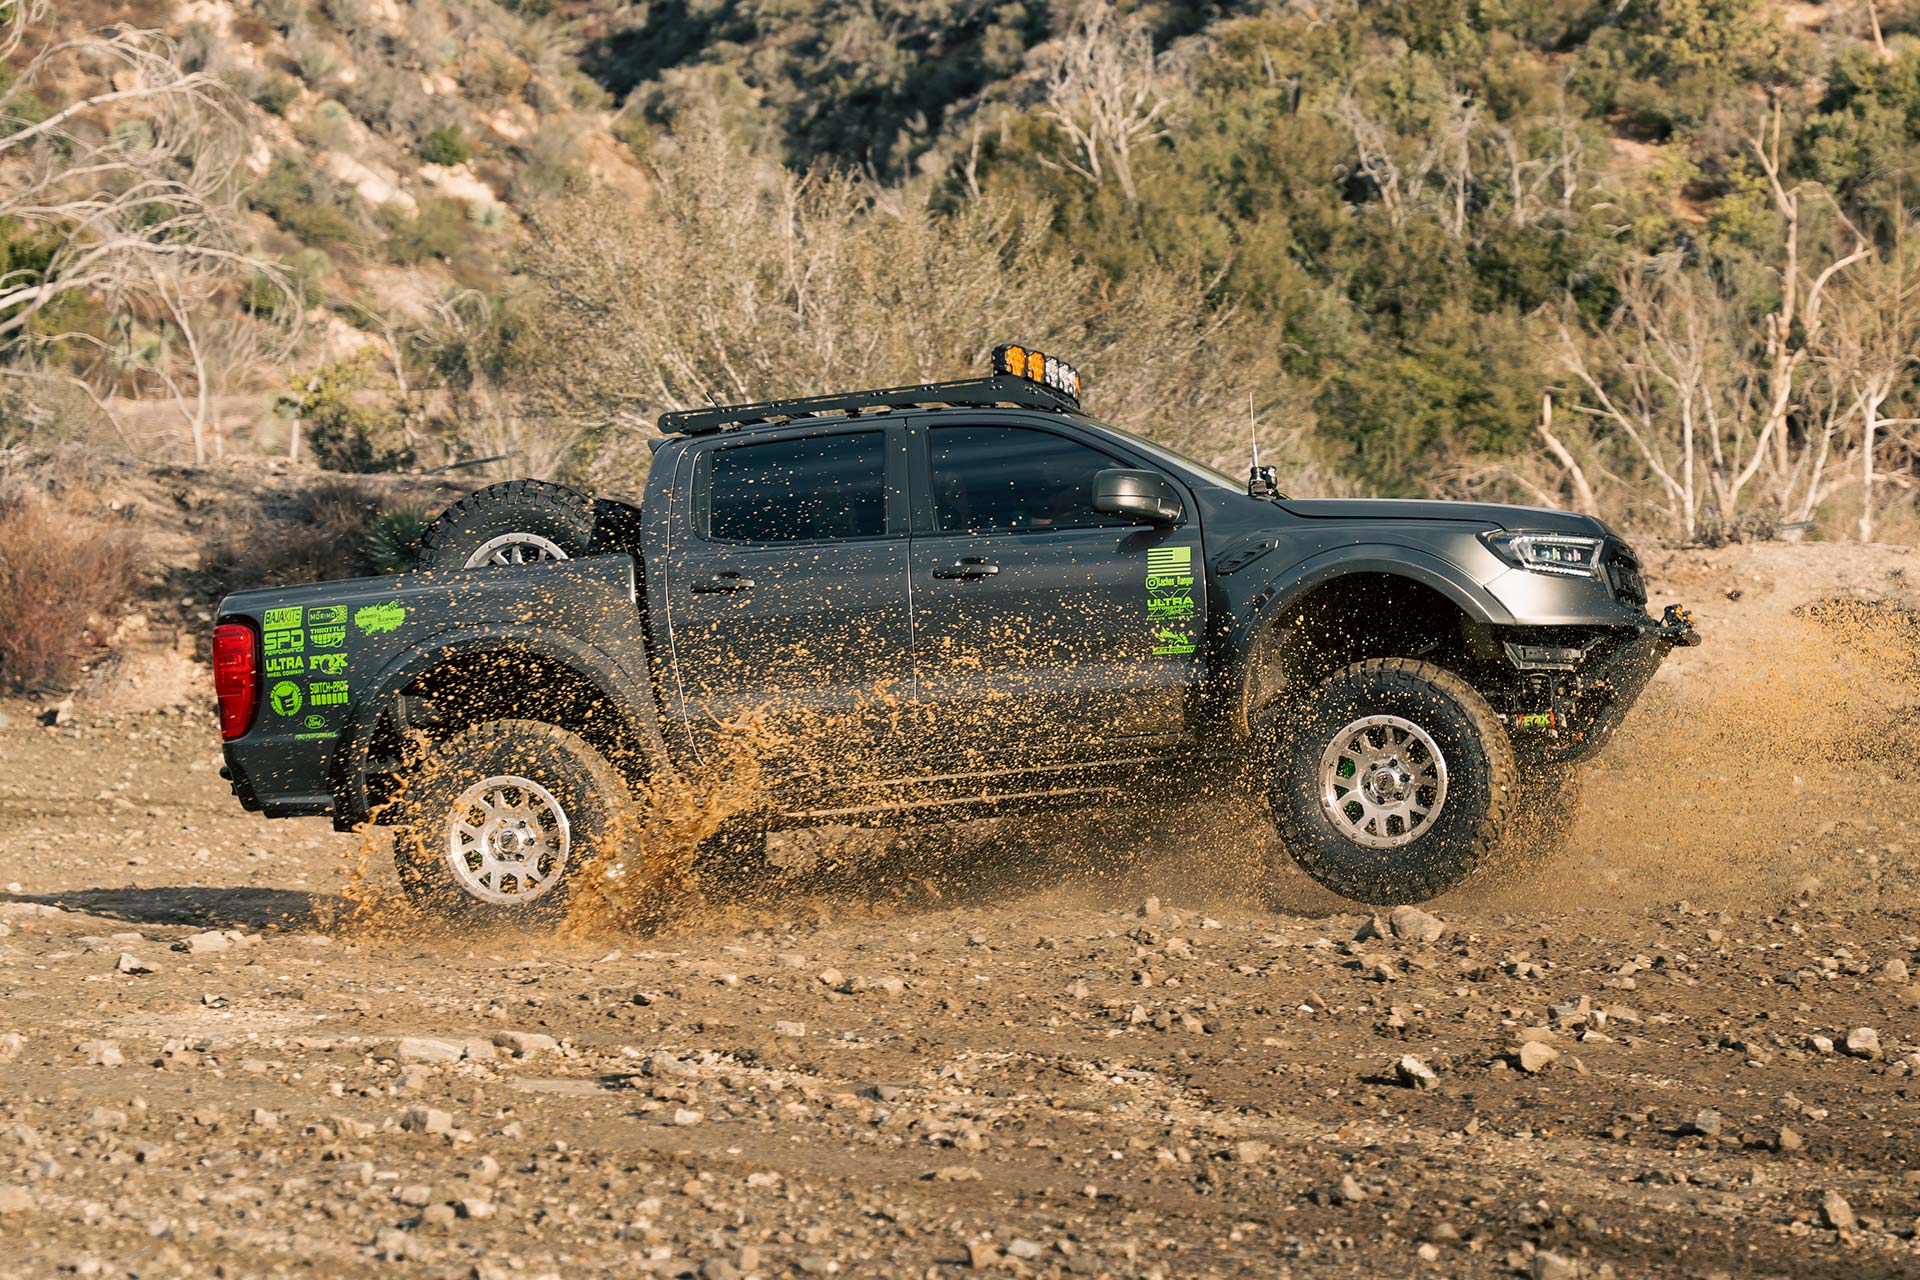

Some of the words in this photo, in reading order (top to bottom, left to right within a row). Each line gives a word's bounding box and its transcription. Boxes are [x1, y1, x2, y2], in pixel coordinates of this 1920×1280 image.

[1147, 596, 1194, 606] ULTRA
[265, 609, 301, 624] BAJAKITS
[310, 626, 346, 634] THROTTLE
[264, 630, 304, 650] SPD
[265, 656, 304, 672] ULTRA
[309, 653, 348, 675] FOX
[282, 669, 304, 677] COMPANY
[307, 715, 322, 727] Ford
[1524, 713, 1550, 729] FOX
